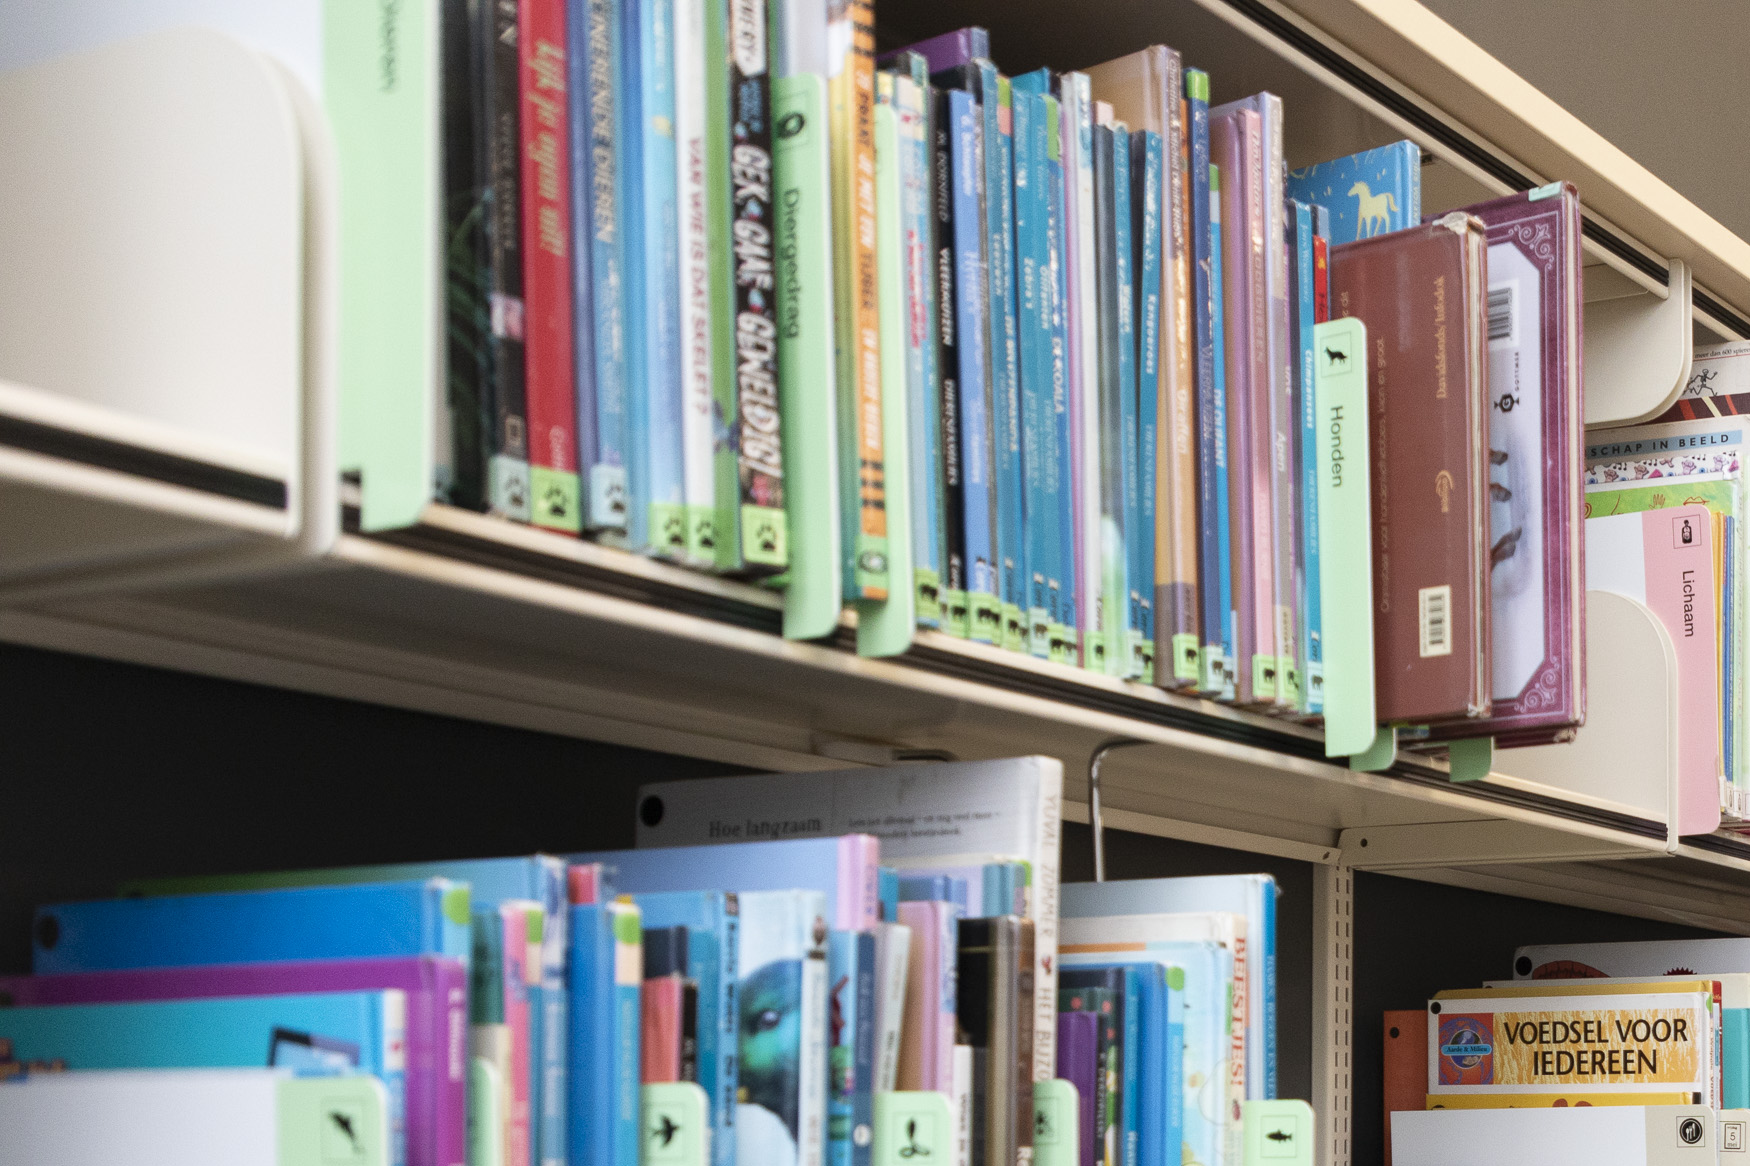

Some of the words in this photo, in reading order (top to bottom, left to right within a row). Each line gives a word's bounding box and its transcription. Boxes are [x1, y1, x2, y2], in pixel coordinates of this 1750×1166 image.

[688, 138, 704, 186] VAN
[731, 144, 771, 203] GEK
[689, 192, 705, 233] WIE
[780, 187, 802, 339] Diergedrag
[692, 267, 708, 312] DAT
[938, 247, 953, 348] VLEERMUIZEN
[692, 315, 710, 397] SKELET
[1052, 359, 1064, 414] KOALA
[1304, 349, 1315, 429] Chimpansees
[1275, 431, 1287, 472] Apen
[1329, 405, 1345, 488] Honden
[1652, 440, 1669, 450] IN
[1678, 433, 1730, 447] BEELD
[1681, 570, 1697, 638] Lichaam
[708, 820, 741, 839] Hoe
[746, 817, 822, 838] langzaam
[1039, 987, 1053, 1021] HET
[1230, 936, 1247, 1086] BEESTJES!
[1470, 1045, 1488, 1053] Milieu
[1503, 1019, 1609, 1046] VOEDSEL
[1615, 1017, 1688, 1043] VOOR
[1533, 1049, 1657, 1076] IEDEREEN
